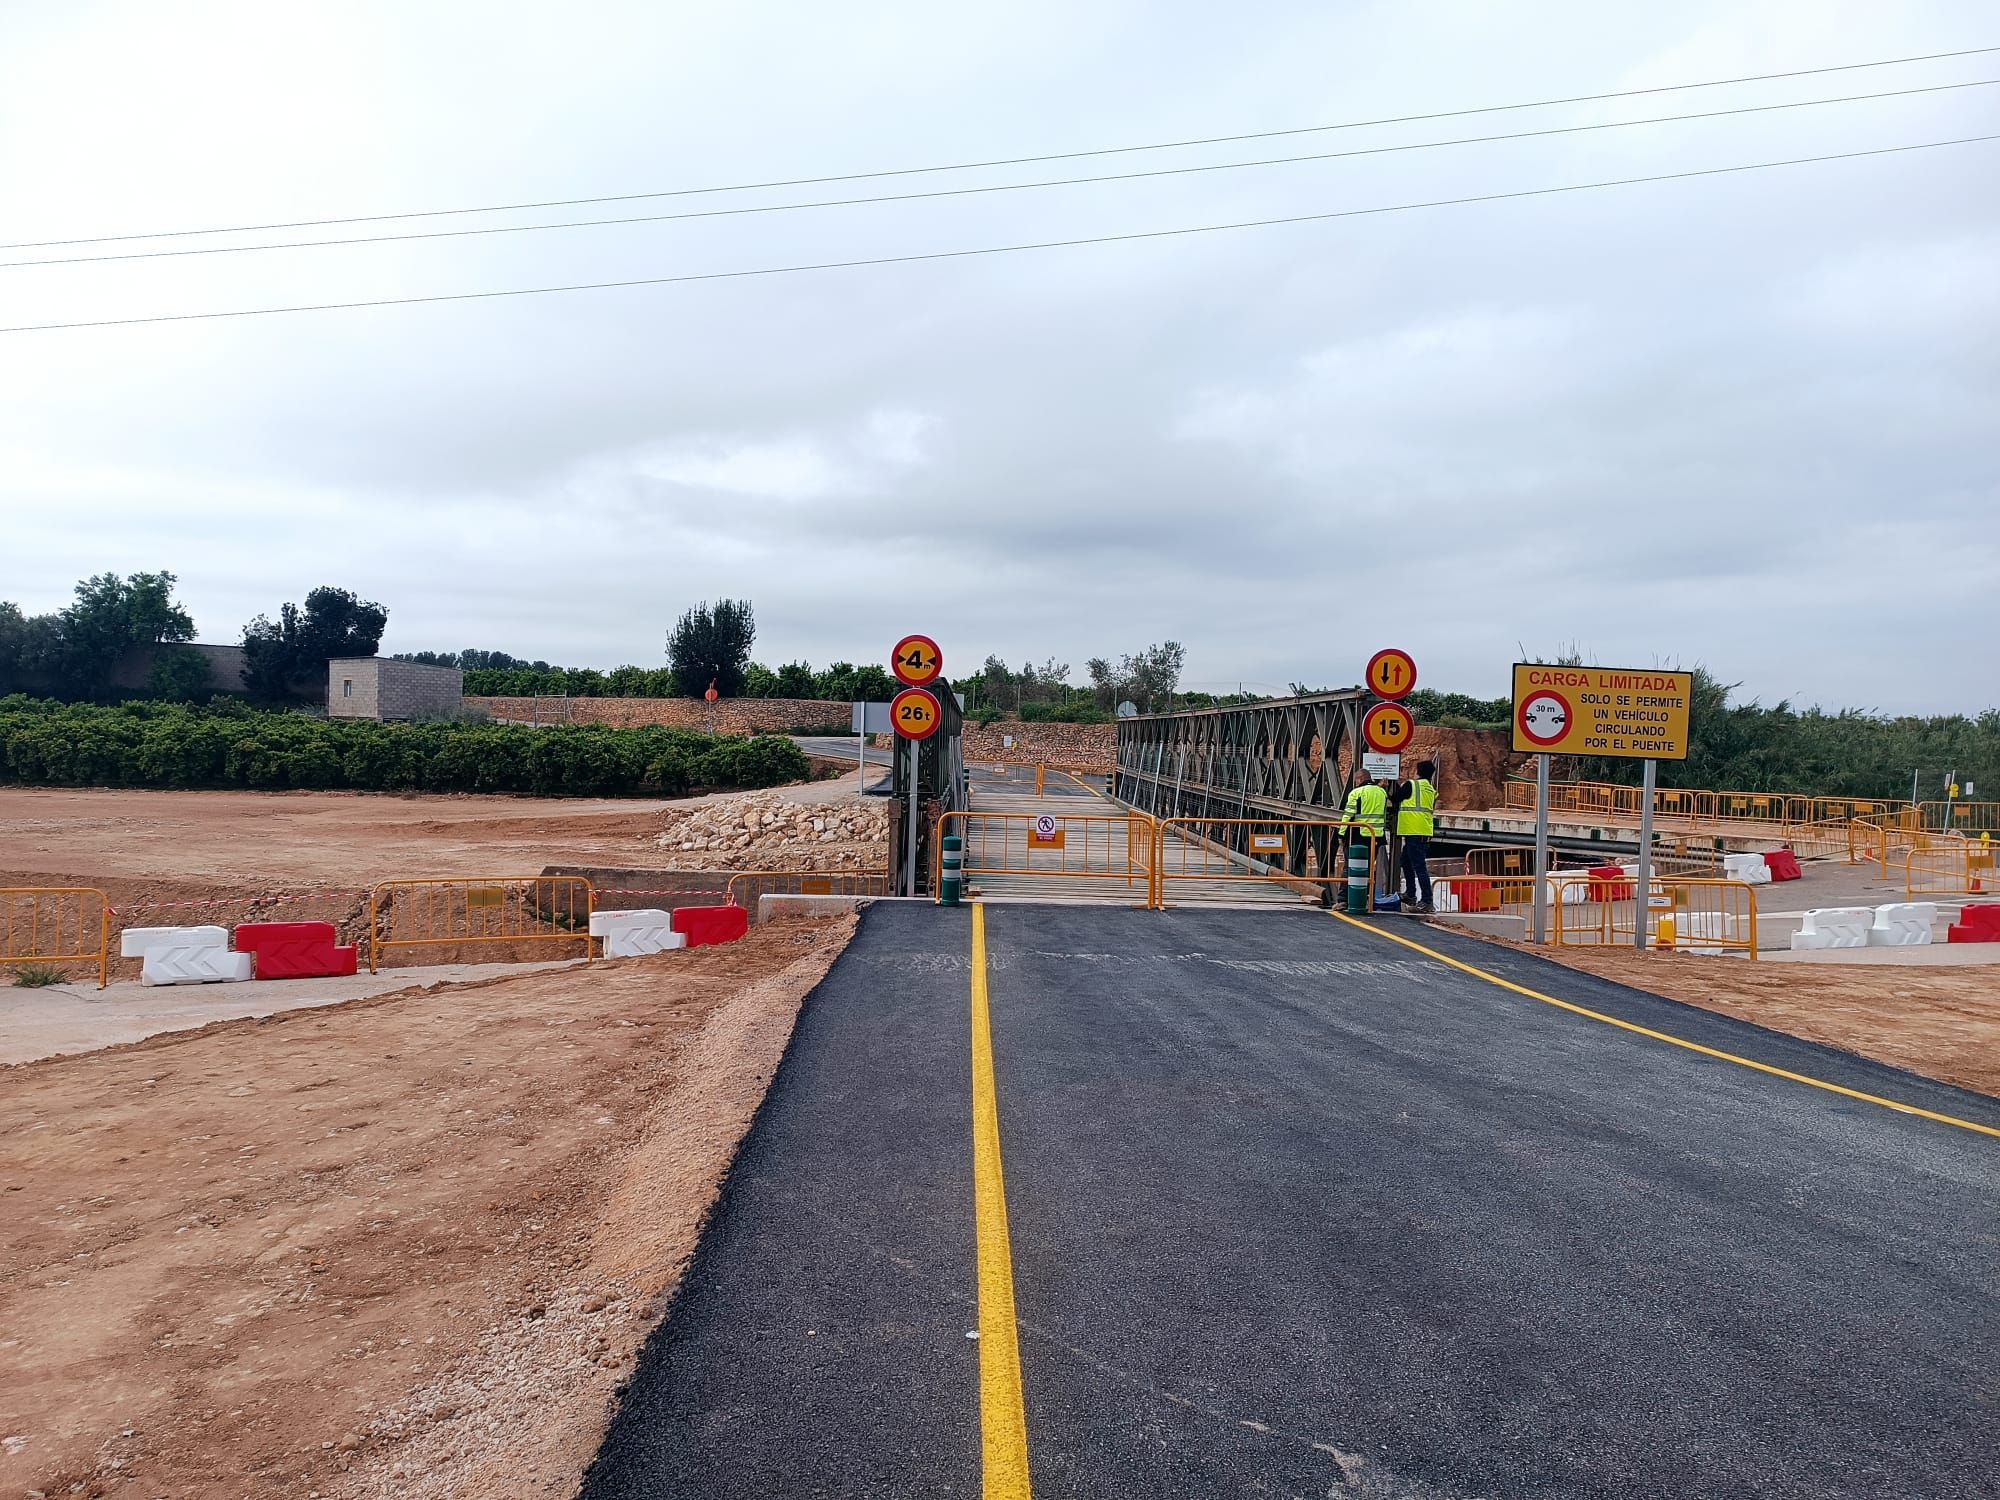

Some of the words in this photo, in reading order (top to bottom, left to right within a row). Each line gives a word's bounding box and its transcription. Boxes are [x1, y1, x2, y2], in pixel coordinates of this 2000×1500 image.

[1529, 671, 1590, 688] CARGA
[1600, 674, 1677, 692] LIMITADA
[1580, 693, 1611, 705] SOLO
[1616, 695, 1631, 706] SE
[1636, 696, 1683, 709] PERMITE
[1535, 704, 1546, 713] 30
[1593, 709, 1609, 719] UN
[1615, 708, 1669, 722] VEHÍCULO
[1379, 719, 1401, 736] 15
[1595, 723, 1666, 737] CIRCULANDO
[1584, 738, 1608, 749] POR
[1613, 739, 1626, 750] EL
[1632, 740, 1675, 752] PUENTE
